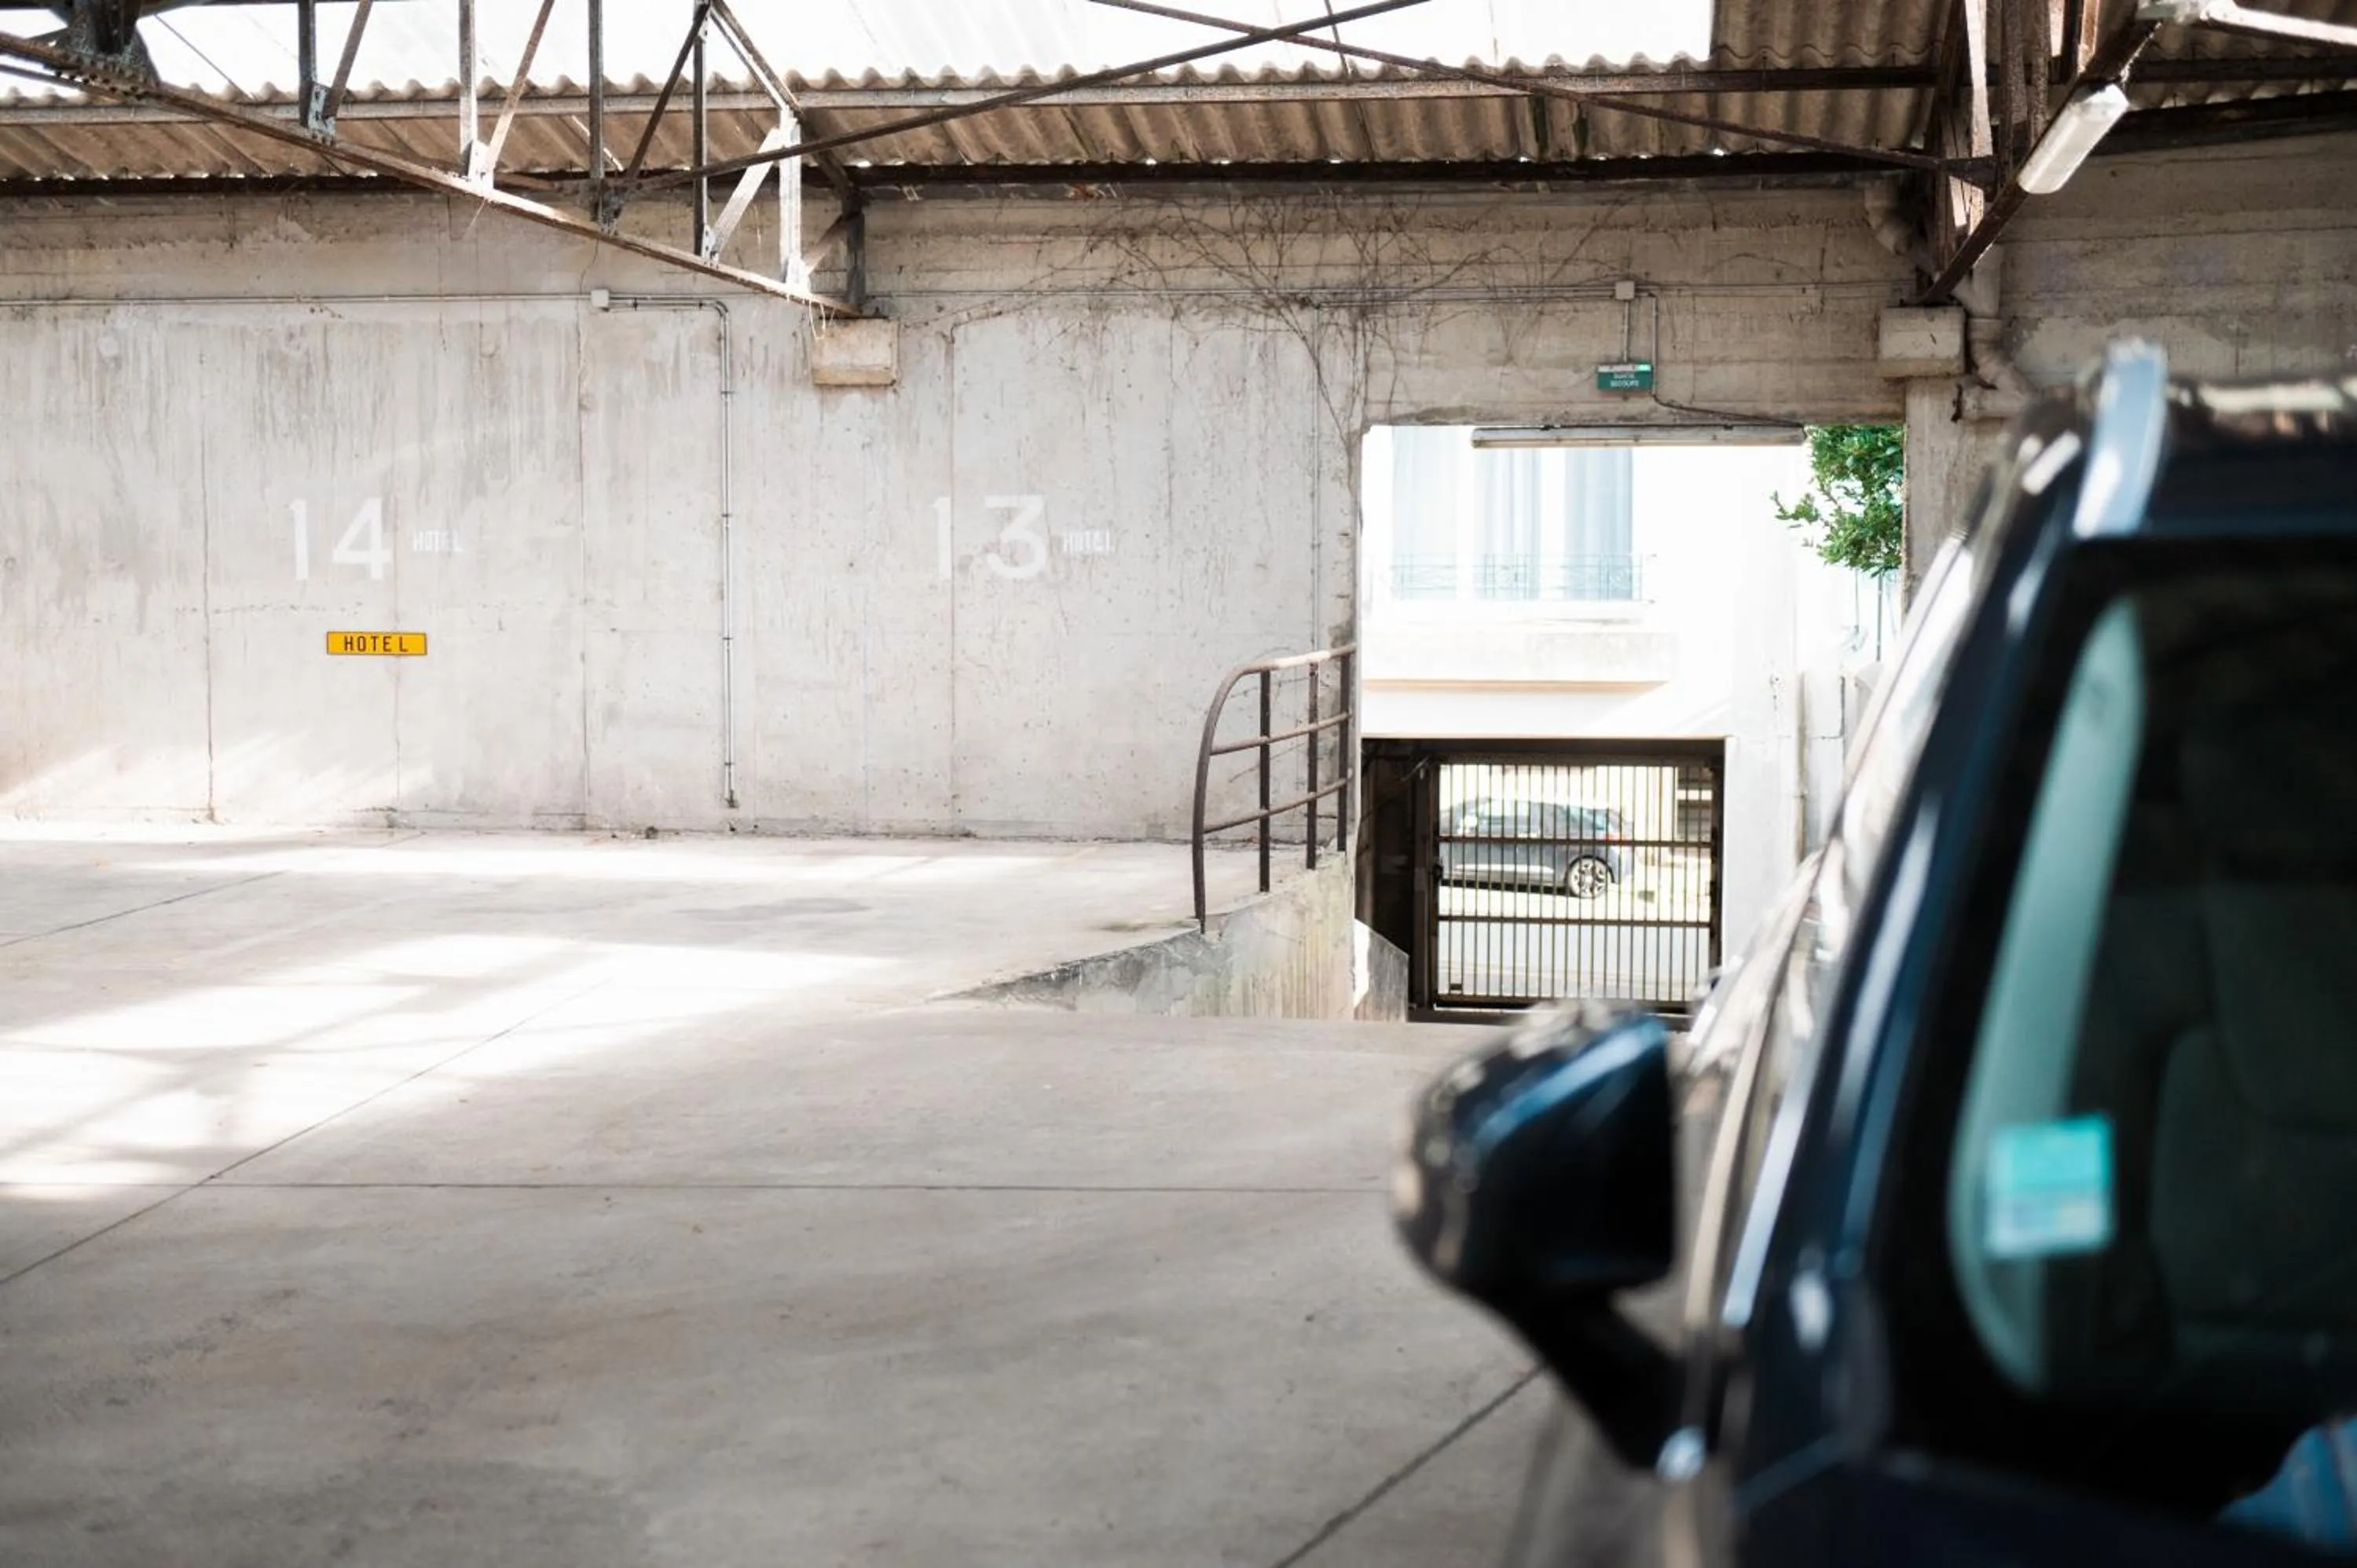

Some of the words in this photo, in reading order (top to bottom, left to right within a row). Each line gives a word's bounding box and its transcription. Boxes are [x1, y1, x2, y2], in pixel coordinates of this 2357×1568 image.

[288, 497, 392, 581] 14
[931, 494, 1047, 580] 13
[343, 635, 409, 653] HOTEL
